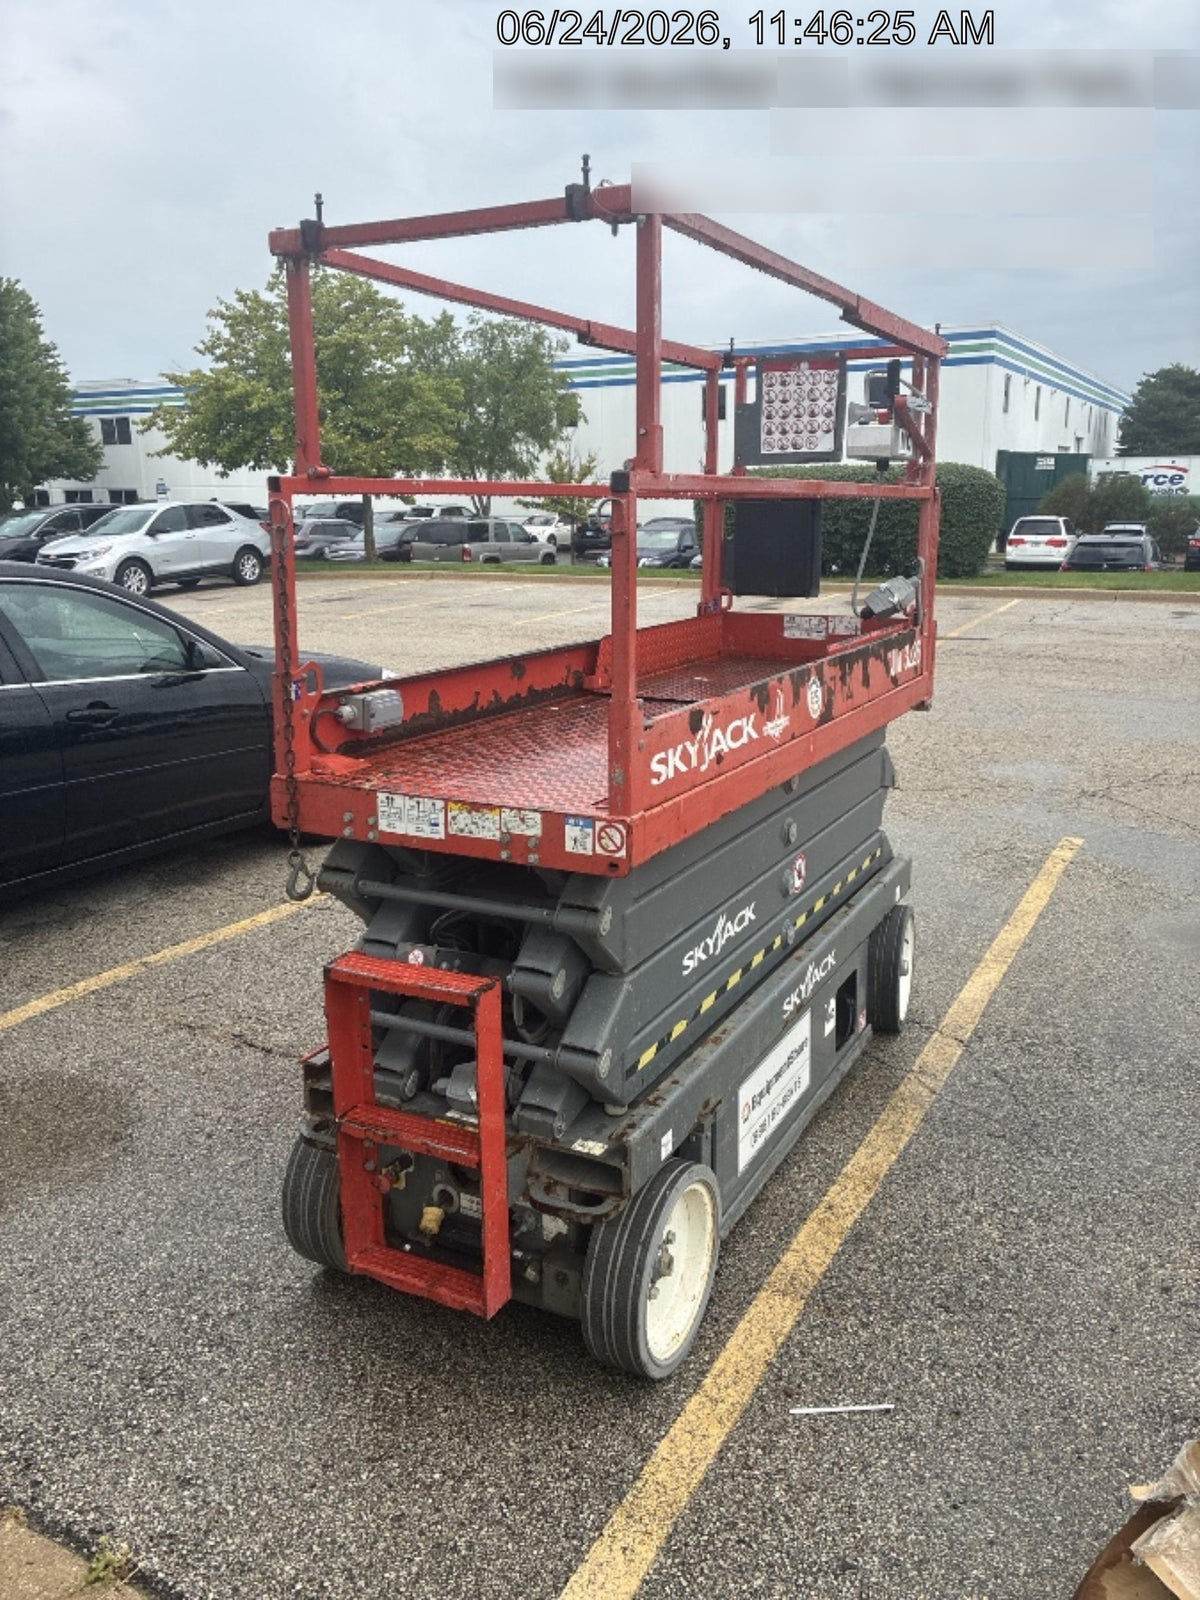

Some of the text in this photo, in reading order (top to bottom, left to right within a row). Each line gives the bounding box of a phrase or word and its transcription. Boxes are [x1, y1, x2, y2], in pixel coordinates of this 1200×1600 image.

[650, 712, 759, 785] SKYJACK
[682, 902, 756, 976] SKYJACK
[782, 949, 836, 1019] SKYJACK
